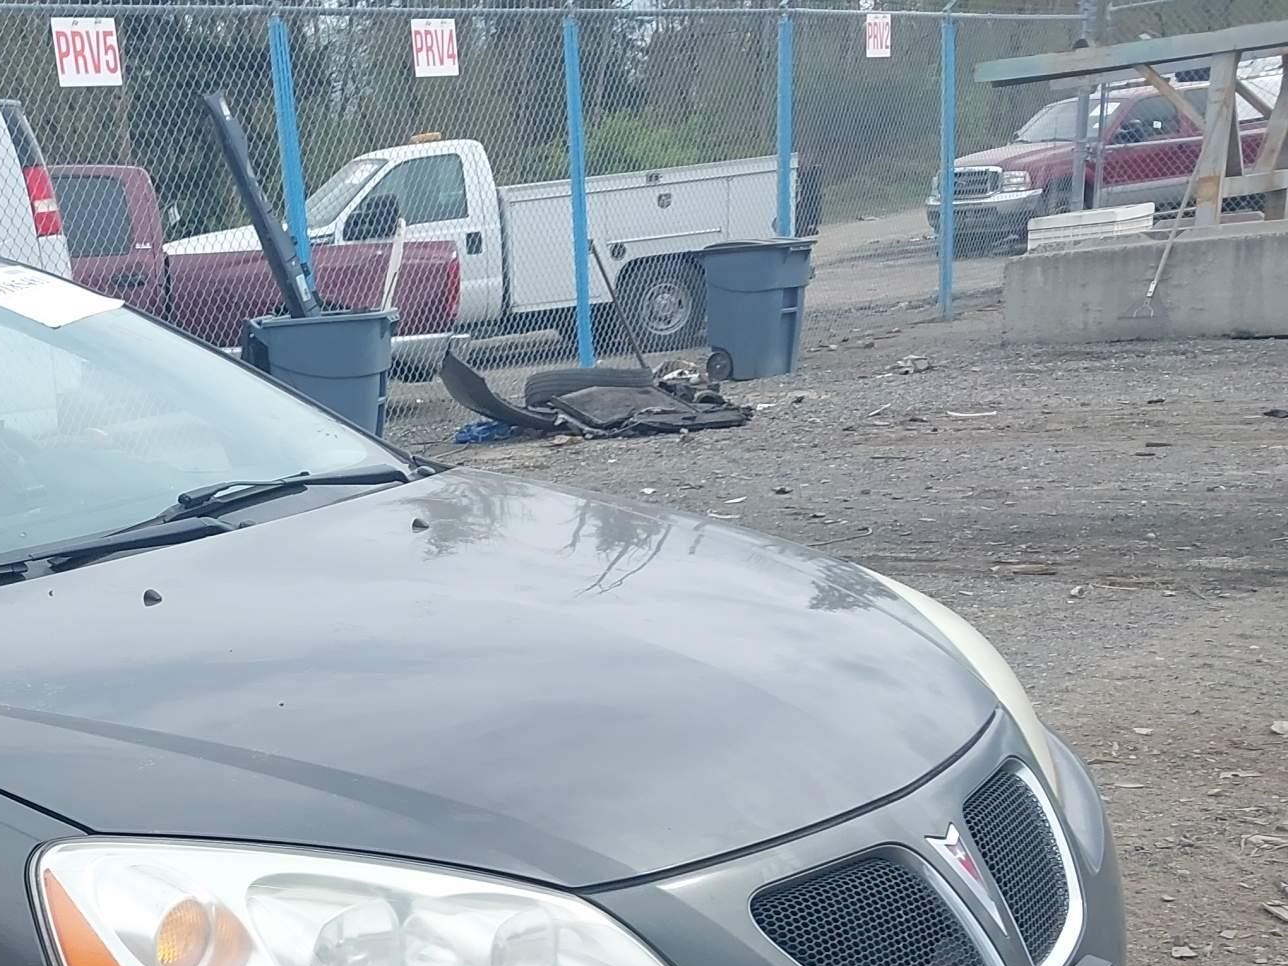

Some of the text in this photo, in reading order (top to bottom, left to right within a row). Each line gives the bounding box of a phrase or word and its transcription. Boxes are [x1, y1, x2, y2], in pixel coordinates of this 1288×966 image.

[55, 30, 118, 75] PRV5
[414, 28, 457, 67] PRV4
[867, 21, 889, 49] PRV2
